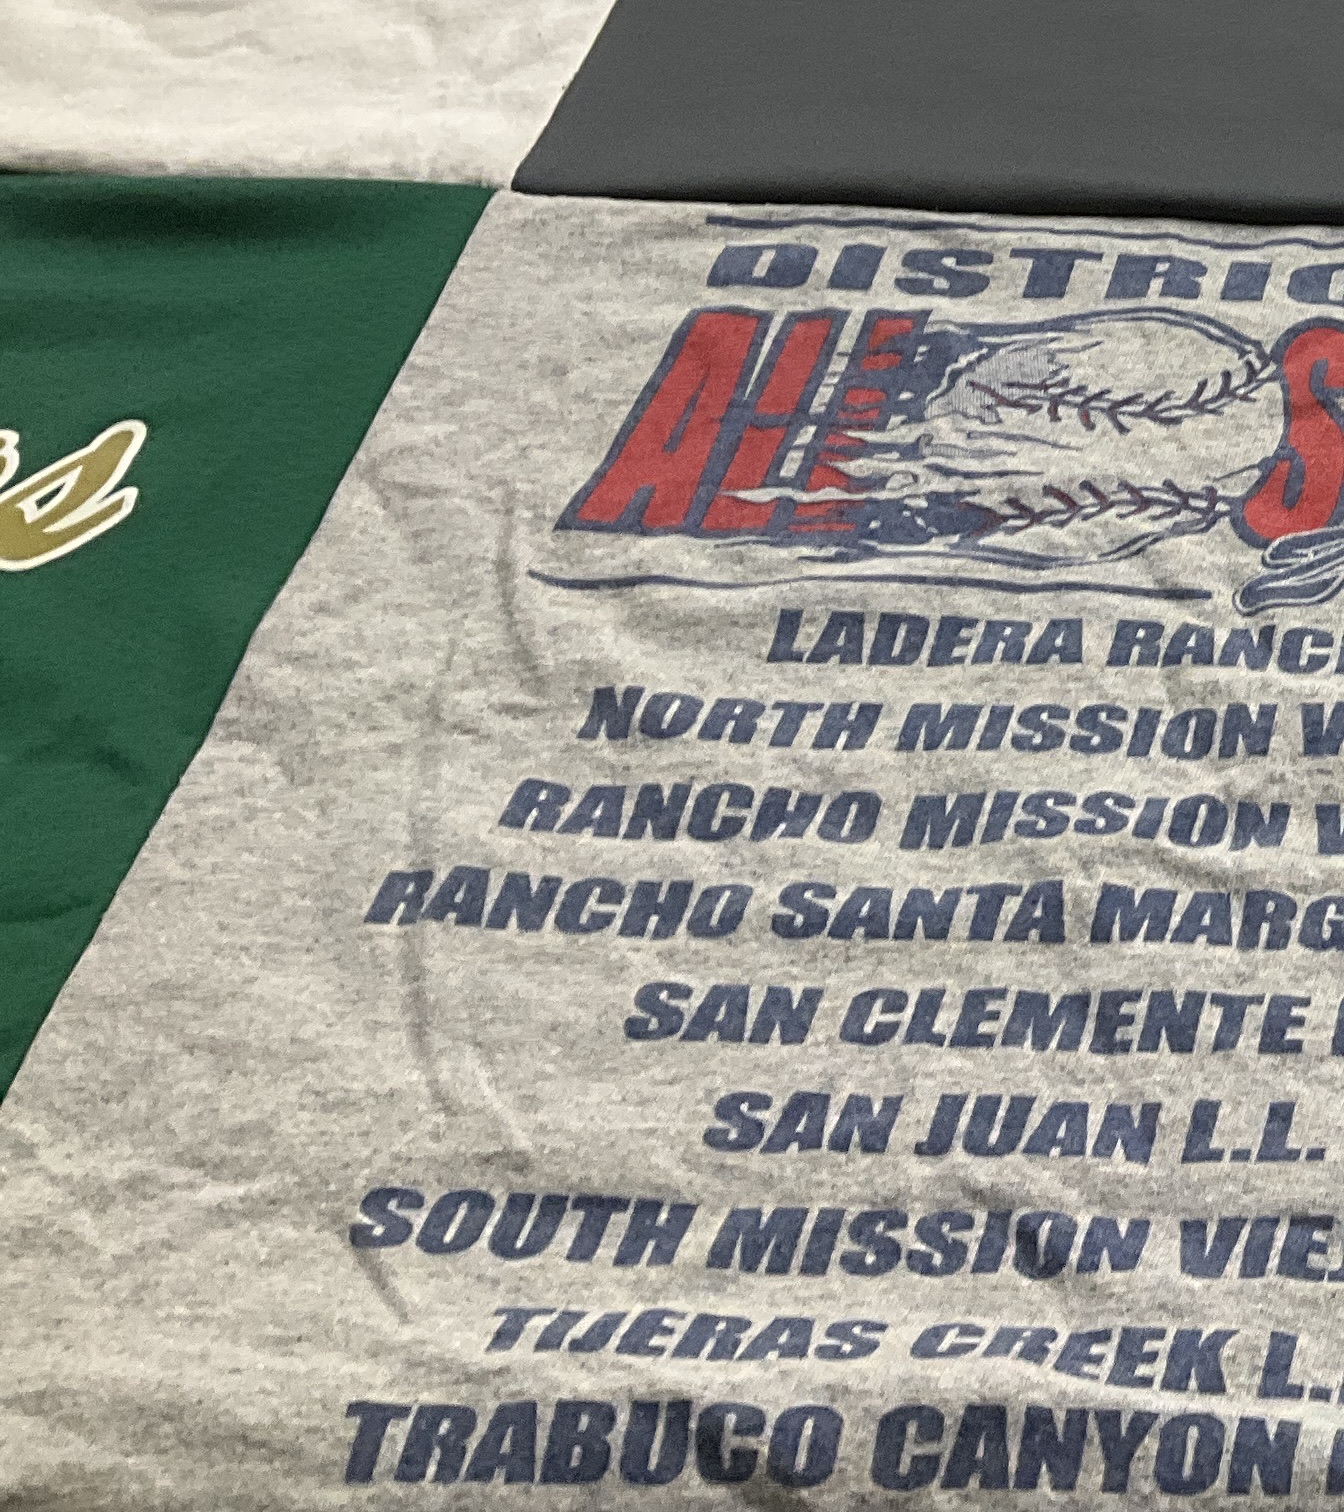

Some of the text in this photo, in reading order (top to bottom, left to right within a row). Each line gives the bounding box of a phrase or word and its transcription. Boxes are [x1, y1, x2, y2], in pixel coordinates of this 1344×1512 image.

[767, 607, 1085, 668] LADERA
[577, 686, 869, 752] NORTH
[895, 703, 1278, 762] MISSION
[497, 777, 881, 846] RANCHO
[900, 790, 1292, 851] MISSION
[364, 867, 748, 938] RANCHO
[770, 880, 1066, 943] SANTA
[624, 981, 817, 1045] SAN
[837, 987, 1313, 1056] CLEMENTE
[703, 1091, 1327, 1163] SAN JUAN L.L.
[348, 1186, 700, 1266] SOUTH
[704, 1199, 1152, 1281] MISSION
[485, 1305, 888, 1363] TIJERAS
[908, 1318, 1237, 1401] CREEK
[344, 1399, 845, 1486] TRABUCO
[870, 1401, 1304, 1496] CANYON
